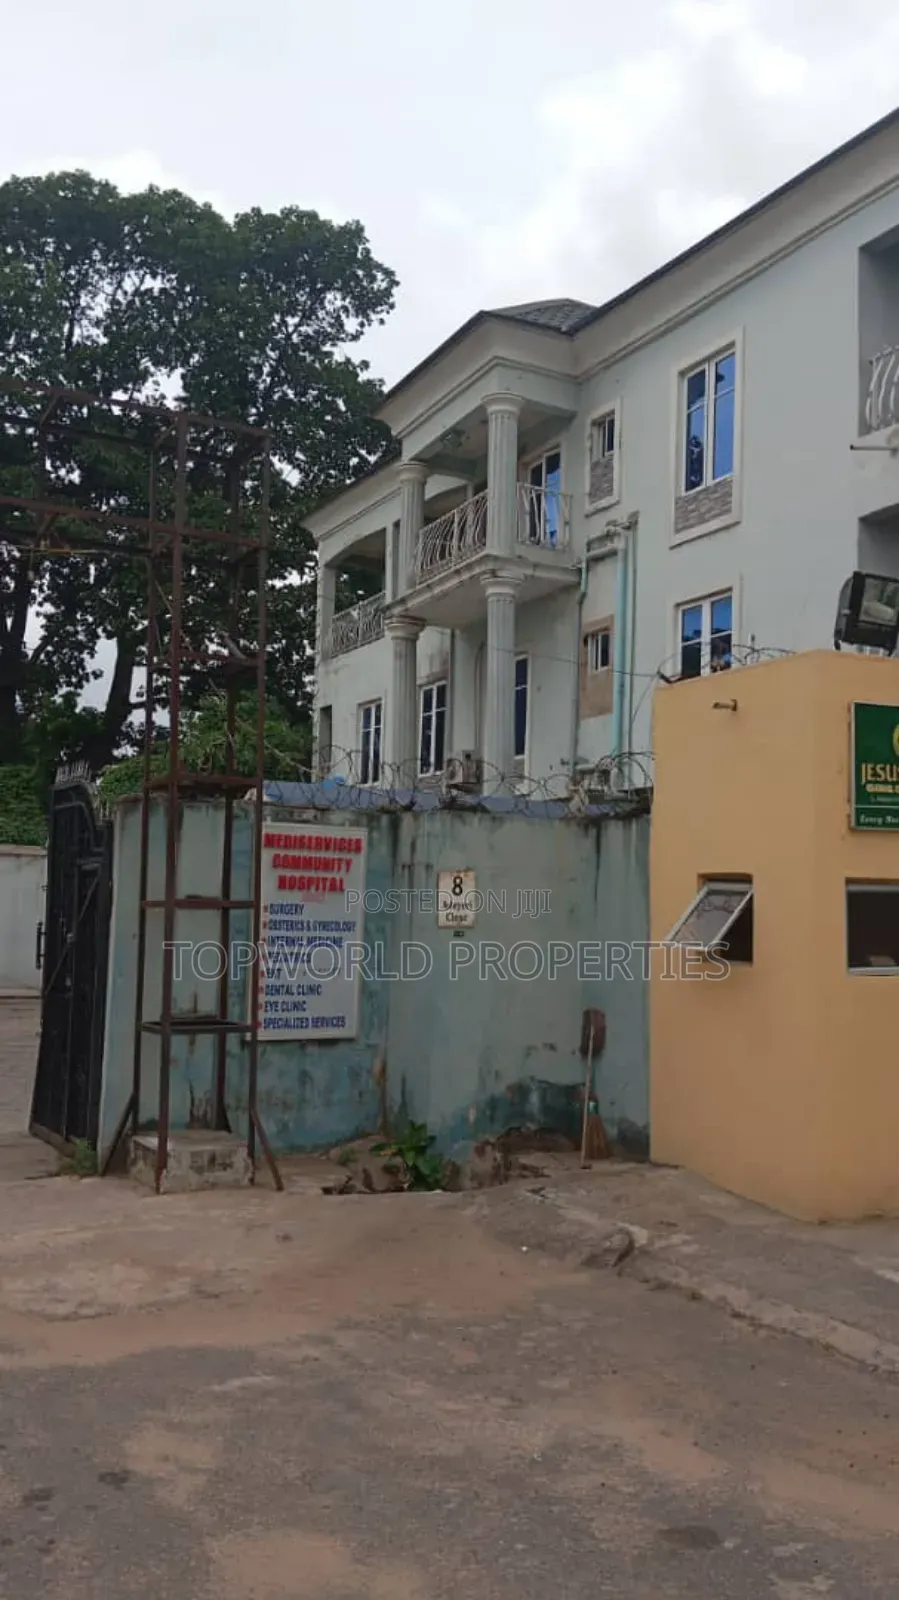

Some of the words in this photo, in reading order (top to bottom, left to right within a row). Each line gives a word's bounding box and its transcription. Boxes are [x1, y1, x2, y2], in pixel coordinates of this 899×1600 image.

[861, 763, 899, 784] JESU
[263, 832, 363, 854] MEDISERVICES
[271, 853, 353, 873] COMMUNITY
[277, 874, 345, 893] HOSPITAL
[452, 876, 463, 896] 8
[269, 903, 305, 915] SURGERY
[264, 984, 295, 996] DENTAL
[297, 983, 323, 996] CLINIC
[264, 1000, 279, 1013] EYE
[281, 1000, 307, 1012] CLINIC
[311, 1015, 346, 1028] SERVICES
